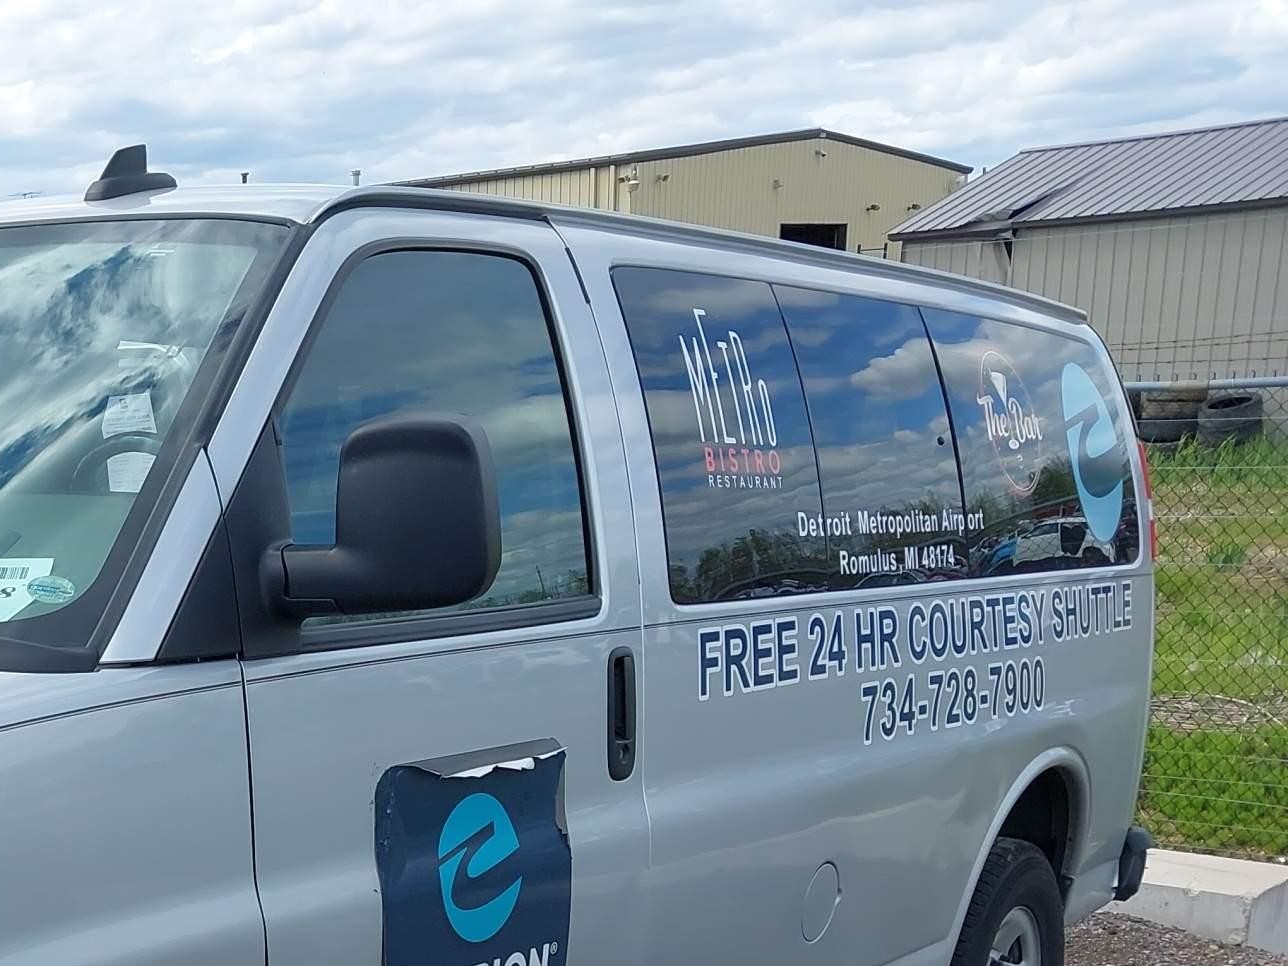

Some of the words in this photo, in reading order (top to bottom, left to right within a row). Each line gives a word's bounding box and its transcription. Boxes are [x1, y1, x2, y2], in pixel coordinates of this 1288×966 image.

[977, 392, 1010, 441] The
[1008, 398, 1043, 443] Bar
[704, 447, 781, 474] BISTRO
[708, 474, 784, 489] RESTAURANT
[797, 511, 852, 537] Detroit
[858, 509, 939, 539] Metropolitan
[942, 508, 985, 537] Airport
[904, 547, 919, 570] MI
[922, 544, 955, 568] 48174
[698, 616, 800, 701] FREE
[808, 610, 847, 680] 24
[854, 606, 902, 673] HR
[908, 591, 1045, 664] COURTESY
[1051, 580, 1132, 642] SHUTTLE
[861, 656, 1044, 745] 734-728-7900
